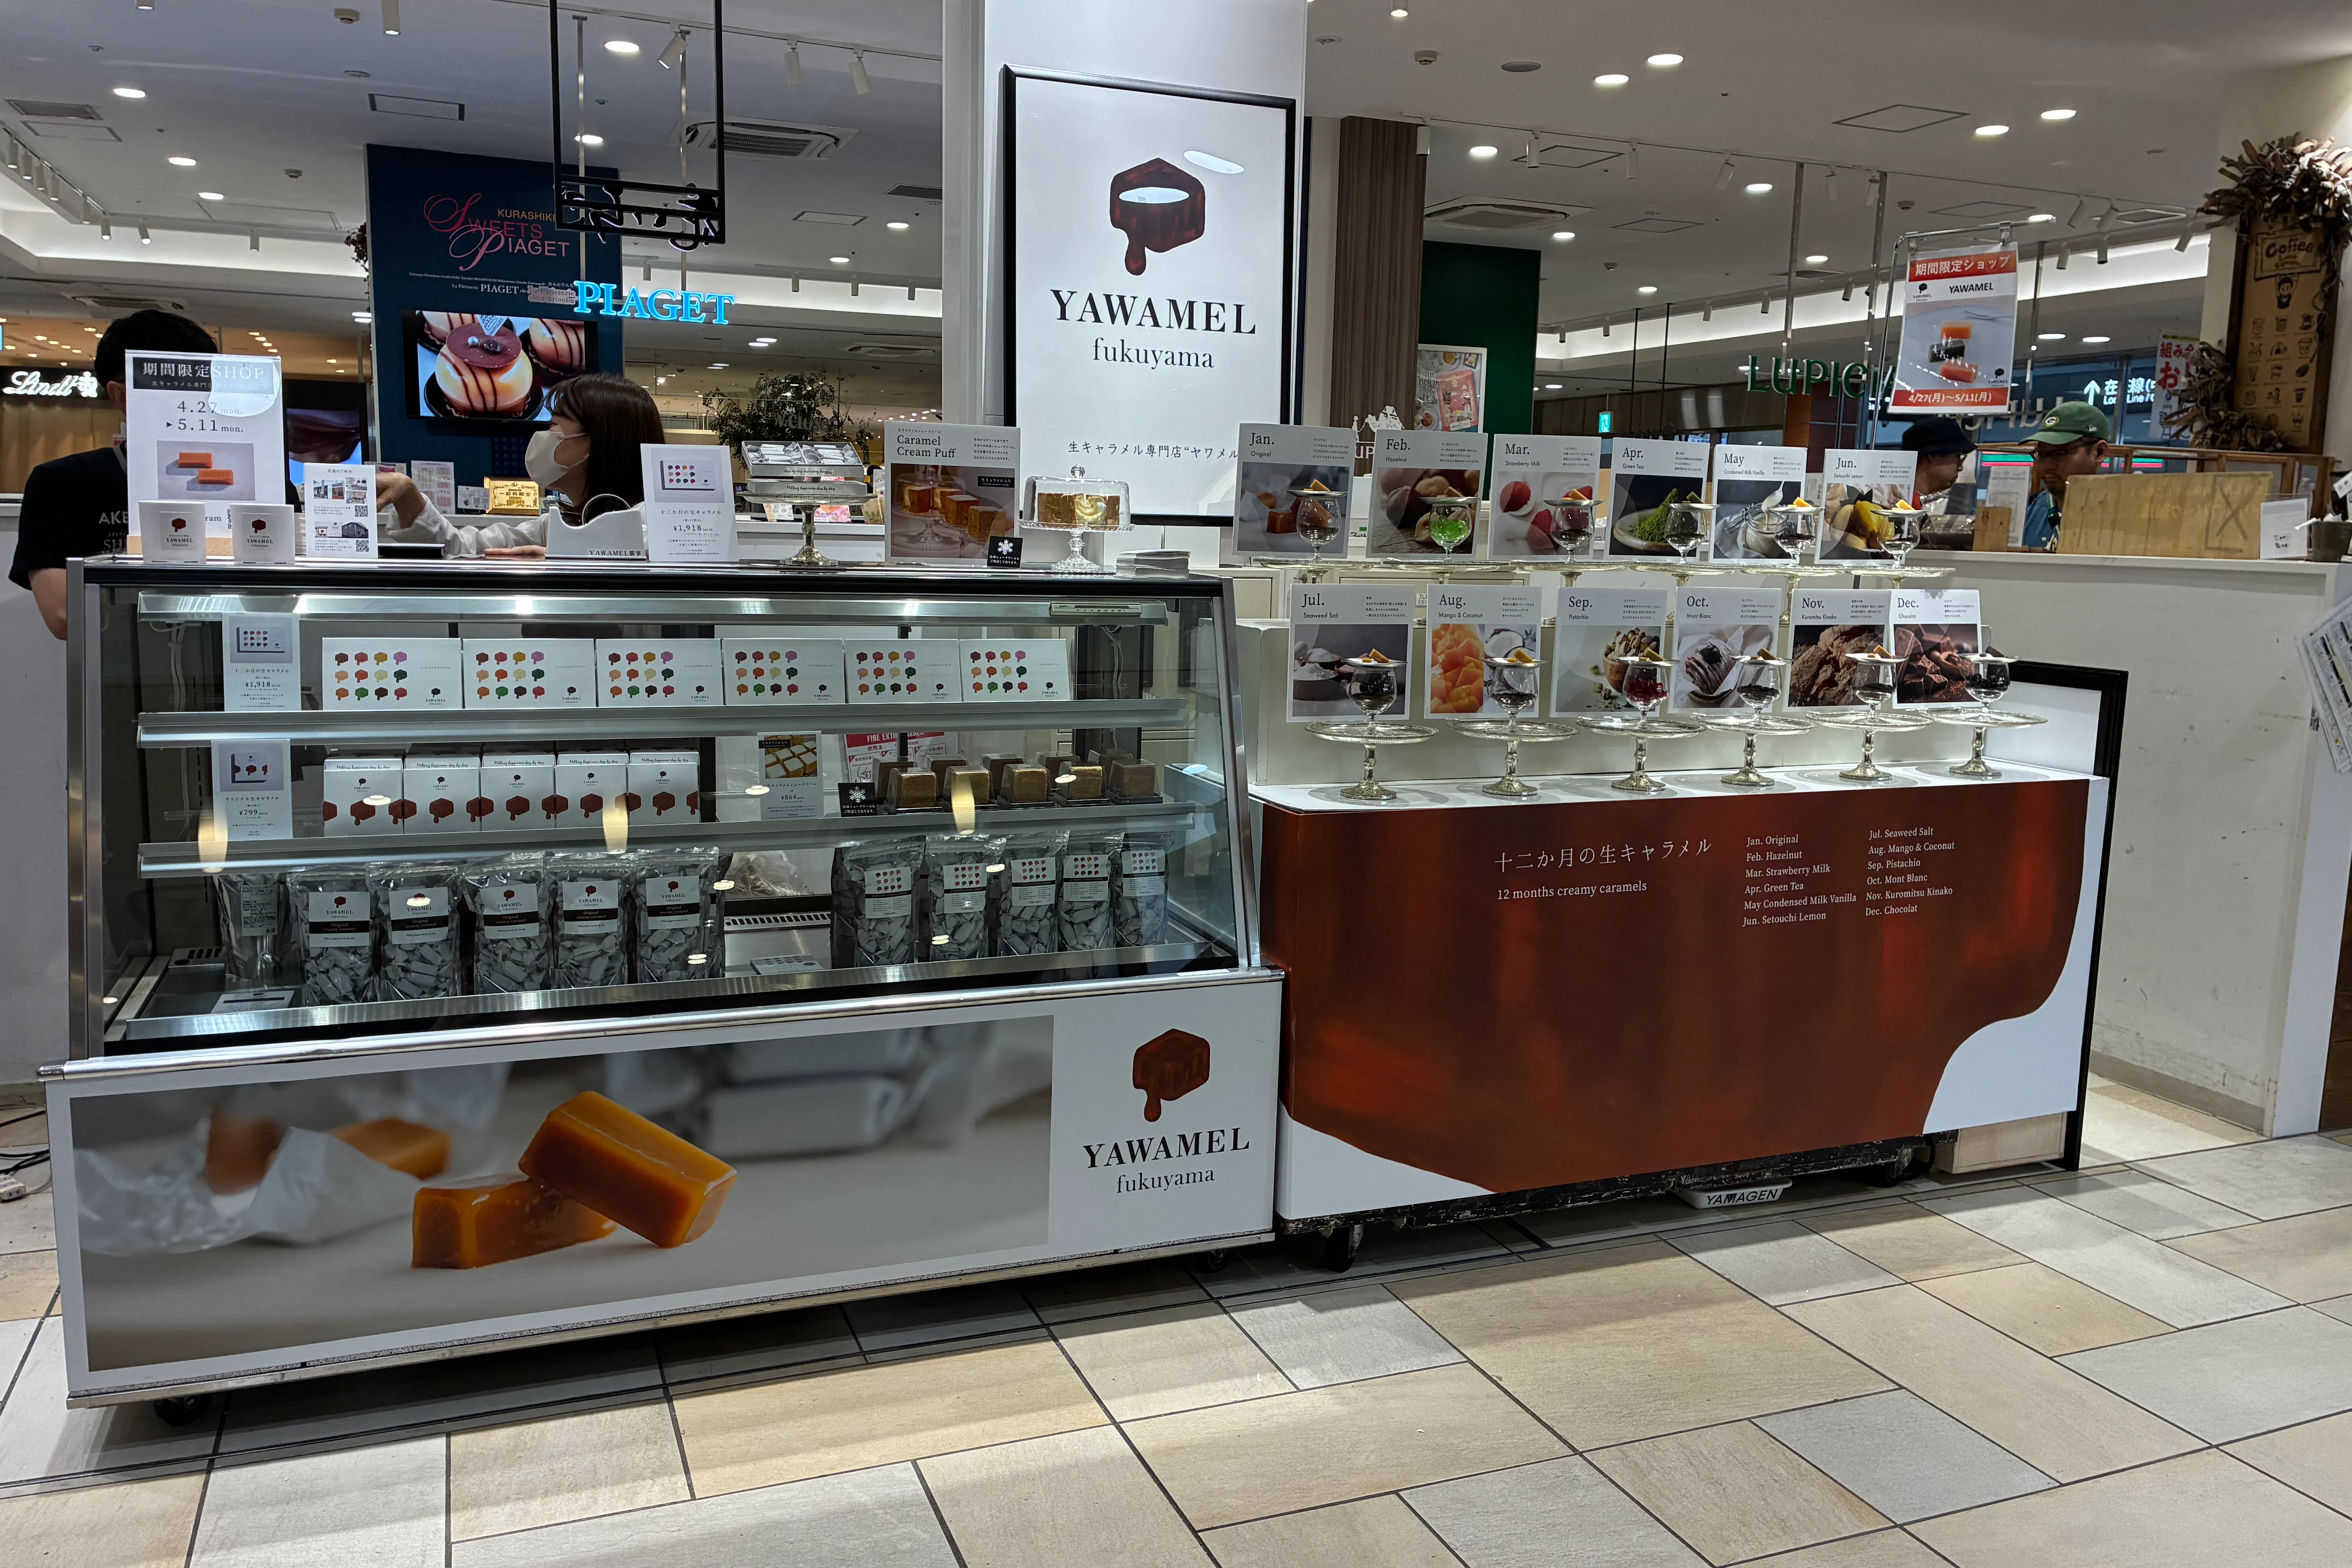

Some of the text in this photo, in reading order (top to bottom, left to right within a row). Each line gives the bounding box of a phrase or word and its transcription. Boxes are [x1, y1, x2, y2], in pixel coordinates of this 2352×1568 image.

[498, 209, 555, 222] KURASHIKI
[448, 224, 569, 271] PIAGET
[2265, 238, 2313, 258] Coffee
[1915, 254, 2011, 276] 期間限定ショップ
[481, 284, 518, 294] PIAGET
[1949, 282, 1993, 294] YAWAMEL
[574, 280, 735, 325] PIAGET
[1050, 289, 1256, 334] YAWAMEL
[1093, 337, 1215, 369] fukuyama
[2, 370, 81, 397] Lindt
[177, 401, 217, 413] 4.27
[178, 418, 218, 431] 5.11
[897, 435, 940, 446] Caramel
[1249, 433, 1274, 446] Jan.
[1386, 439, 1410, 450] Feb.
[897, 446, 957, 458] Cream Puff
[1505, 443, 1530, 455] Mar.
[1622, 447, 1643, 461] Apr.
[1724, 453, 1744, 467] May
[1836, 458, 1856, 469] Jun.
[1302, 593, 1324, 607] Jul.
[1439, 594, 1465, 609] Aug.
[1569, 596, 1592, 611] Sep.
[1687, 596, 1708, 607] Oct.
[1802, 598, 1824, 608] Nov.
[1897, 598, 1919, 608] Dec.
[1869, 826, 1933, 840] Jul. Seaweed Salt
[1747, 834, 1799, 847] Jan. Original
[1747, 850, 1802, 861] Feb. Hazelnut
[1869, 845, 1885, 856] Aug.
[1888, 844, 1913, 855] Mango
[1924, 841, 1955, 851] Coconut
[1495, 839, 1712, 873] 十二か月の生キャラメル
[1745, 864, 1831, 877] Mar. Strawberry Milk
[1868, 859, 1920, 871] Sep. Pistachio
[1867, 874, 1928, 885] Oct. Mont Blanc
[1497, 880, 1647, 900] 12 months creamy caramels
[1745, 882, 1804, 896] Apr. Green Tea
[1866, 886, 1953, 901] Nov. Kuromitsu Kinako
[1744, 893, 1856, 912] May Condensed Milk Vanilla
[1865, 904, 1917, 916] Dec. Chocolat
[1743, 912, 1826, 927] Jun. Setouchi Lemon
[1083, 1127, 1249, 1168] YAWAMEL
[1116, 1169, 1215, 1193] fukuyama
[1707, 1189, 1778, 1205] YAMAGEN
